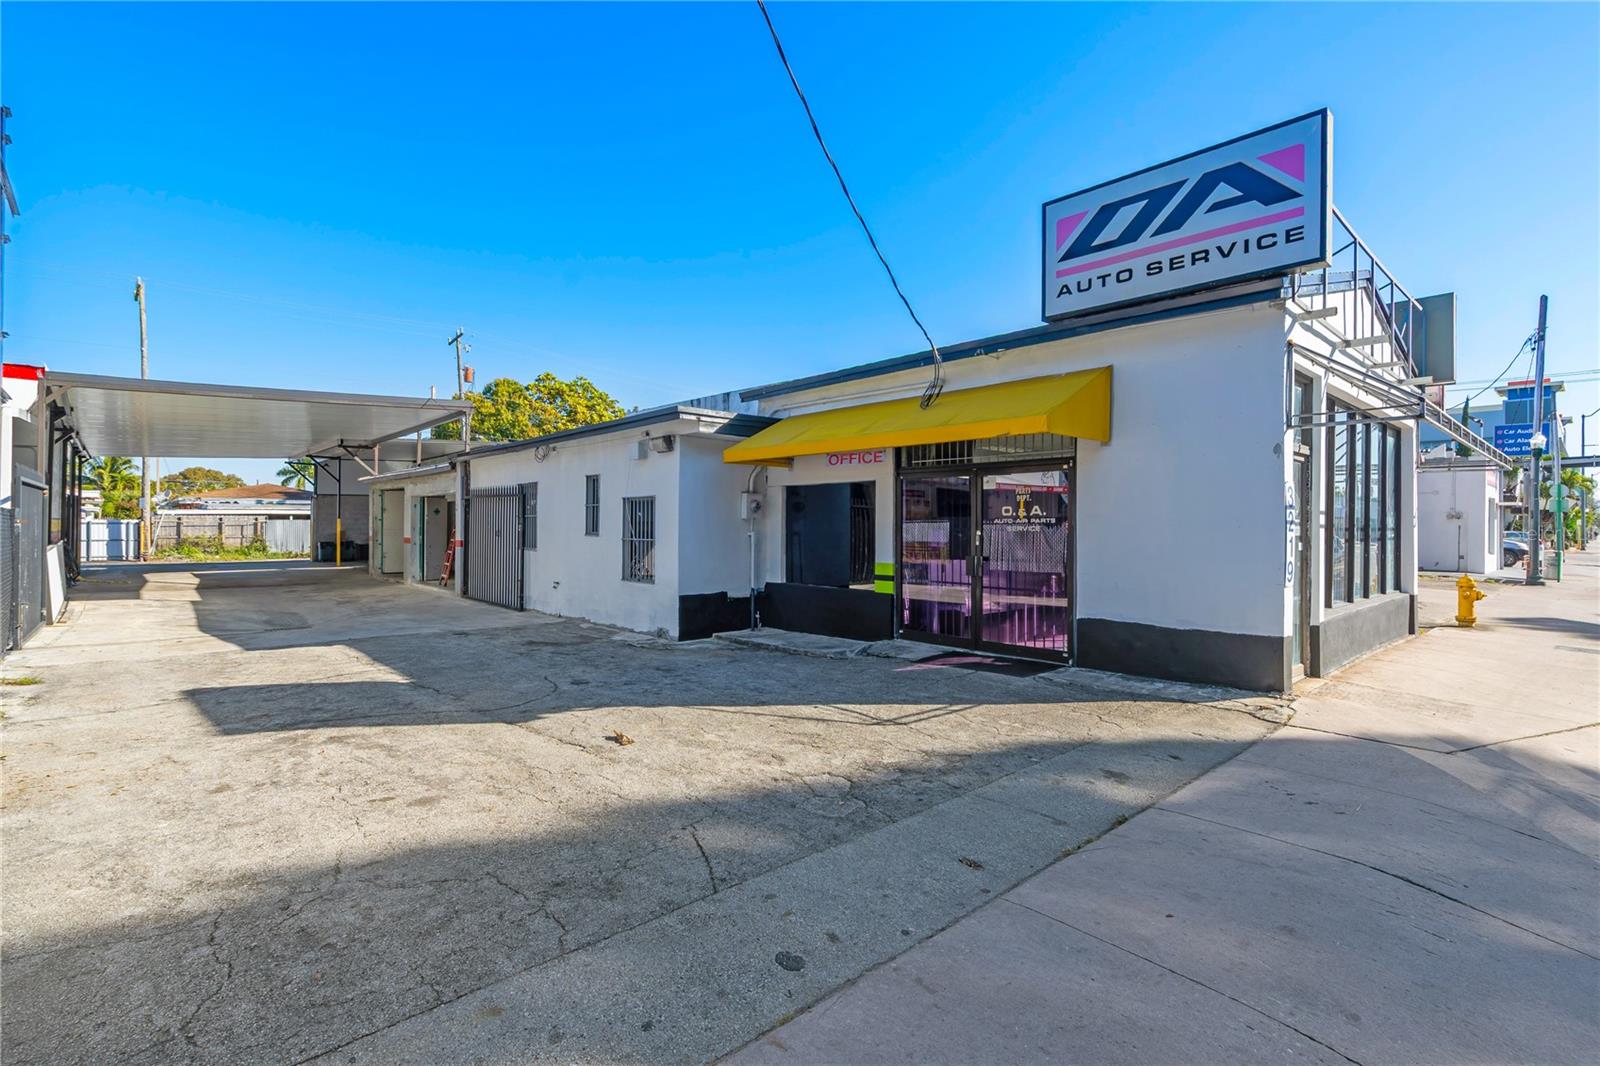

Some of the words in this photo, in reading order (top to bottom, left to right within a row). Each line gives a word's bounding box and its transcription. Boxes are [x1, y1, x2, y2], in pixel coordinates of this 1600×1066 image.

[1056, 268, 1133, 299] AUTO
[1146, 225, 1305, 276] SERVICE
[828, 450, 883, 466] OFFICE
